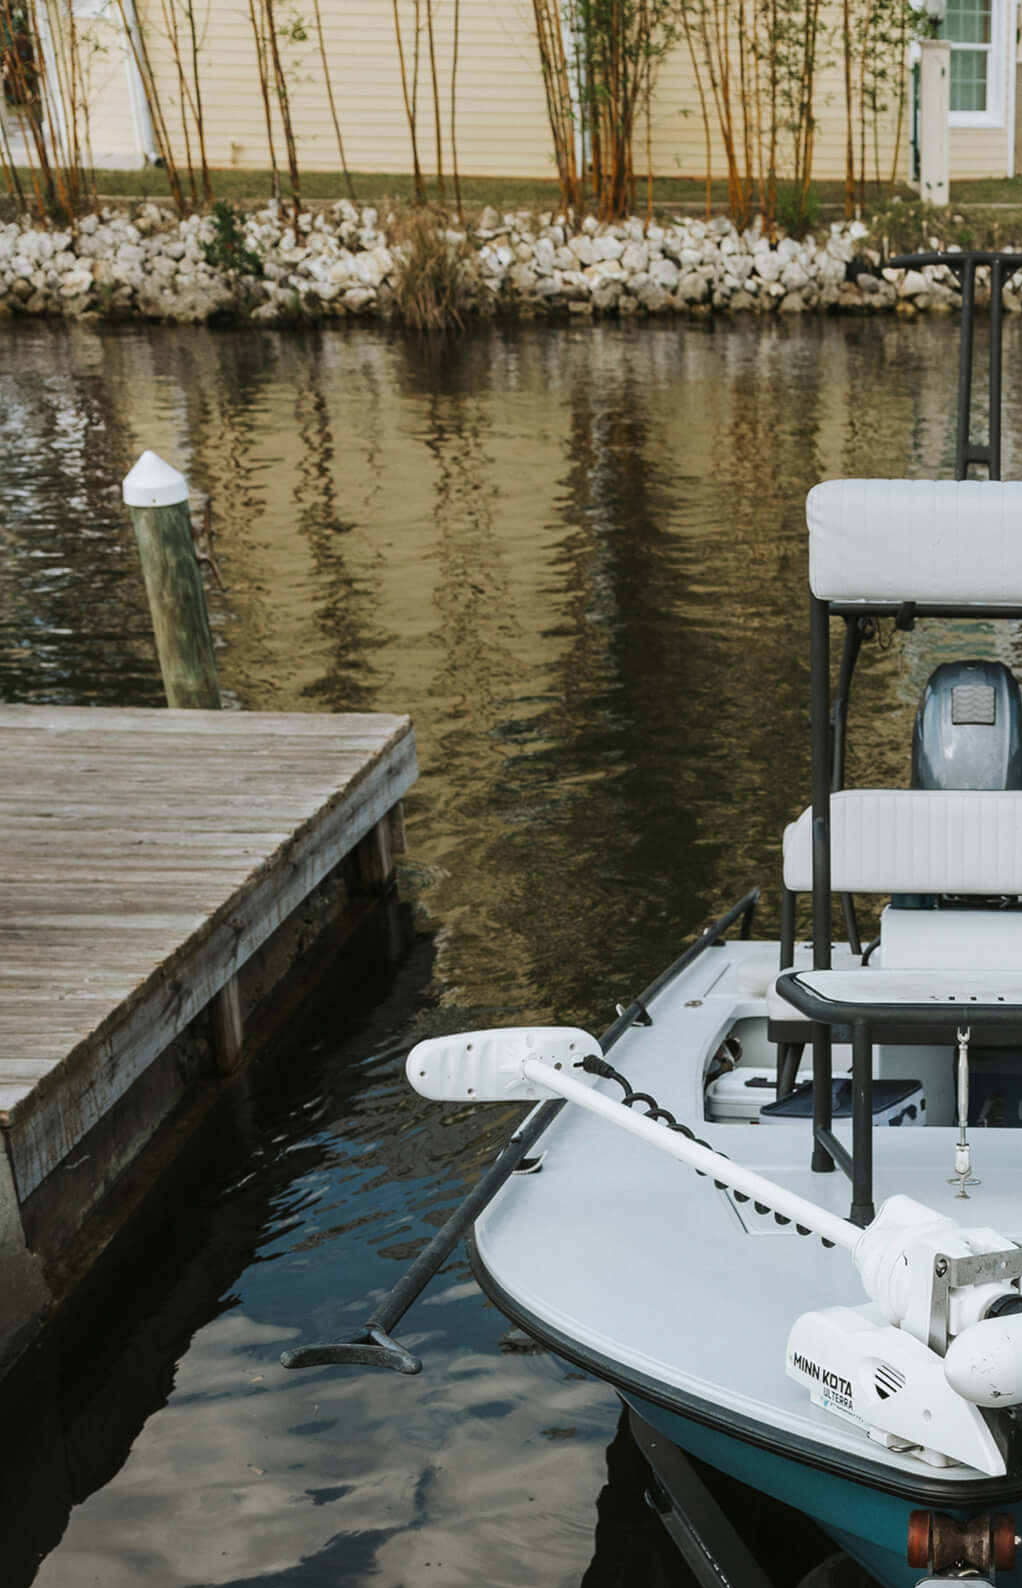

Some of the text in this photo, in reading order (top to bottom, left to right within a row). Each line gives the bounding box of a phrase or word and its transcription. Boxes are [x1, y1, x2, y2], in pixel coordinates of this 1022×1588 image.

[793, 1352, 853, 1398] MINN KOTA
[823, 1387, 854, 1411] ULTERRA
